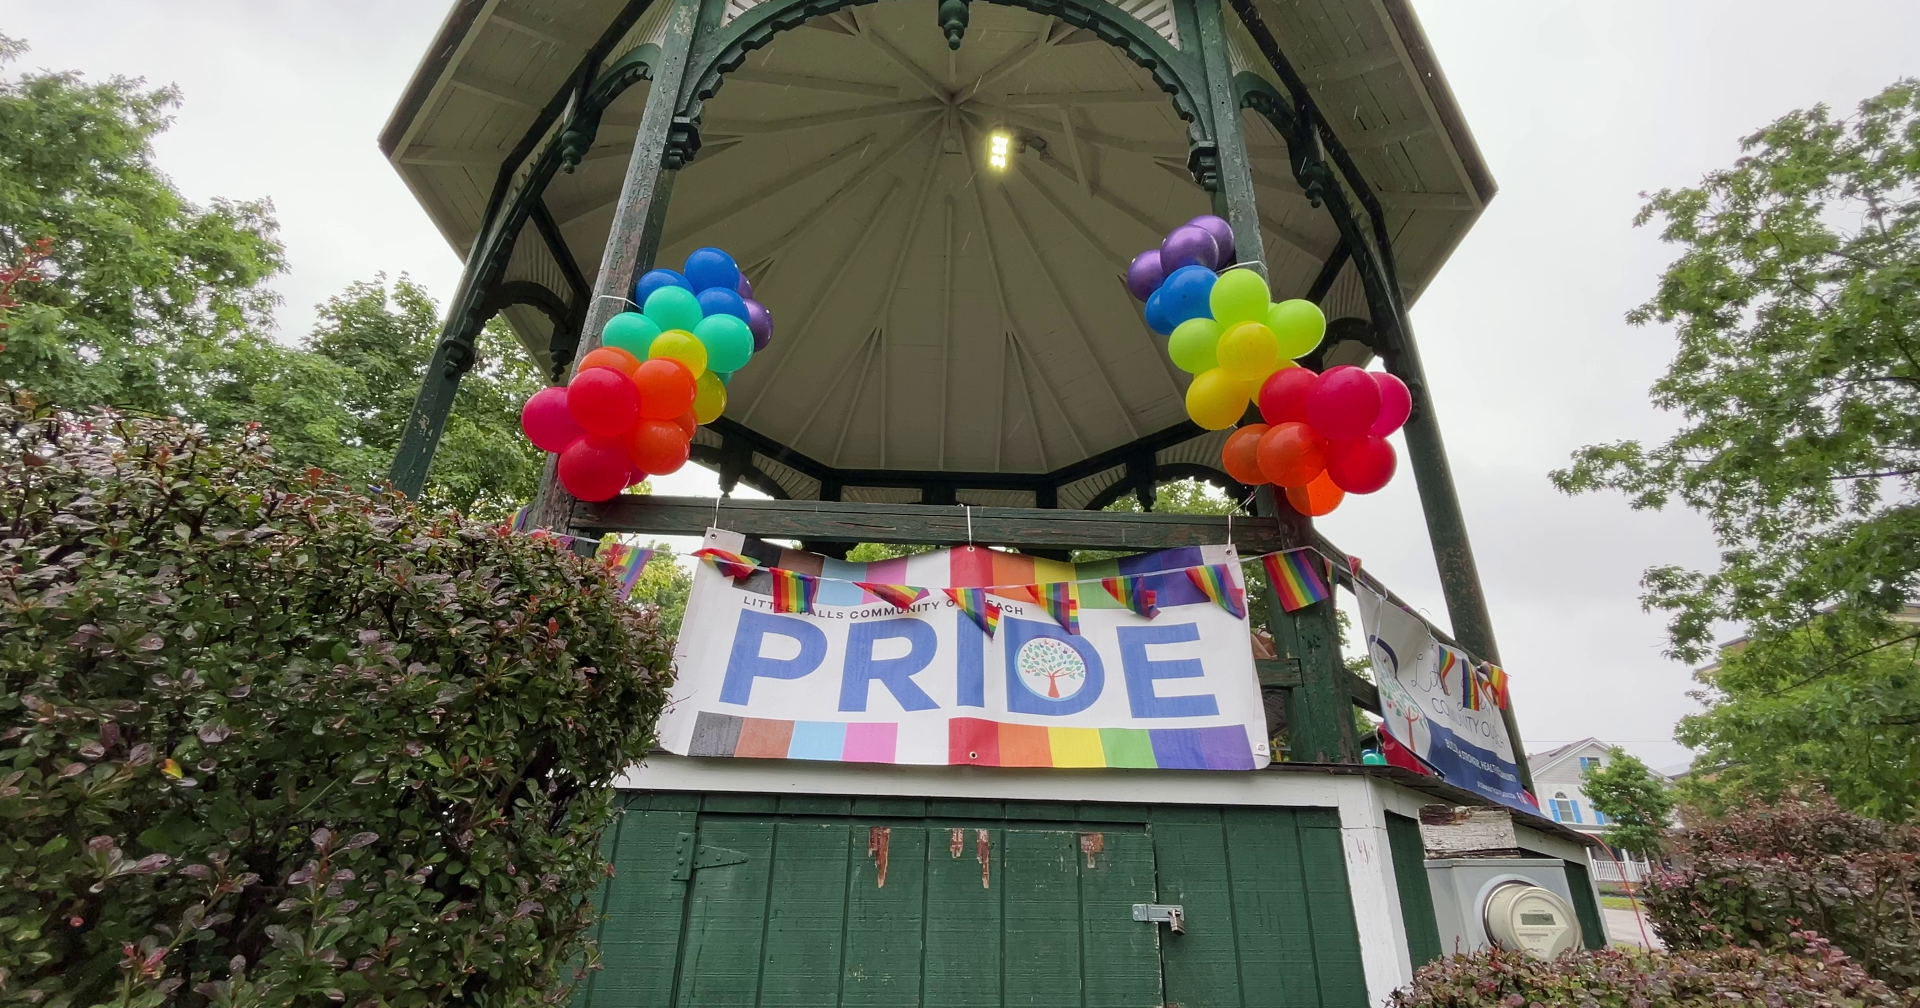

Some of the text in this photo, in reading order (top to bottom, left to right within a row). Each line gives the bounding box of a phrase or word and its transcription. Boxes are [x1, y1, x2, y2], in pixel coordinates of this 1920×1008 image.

[849, 601, 940, 620] COMMUNITY
[946, 599, 1024, 615] OEACH
[719, 608, 1220, 718] PRIDE
[1431, 697, 1479, 734] CONITY
